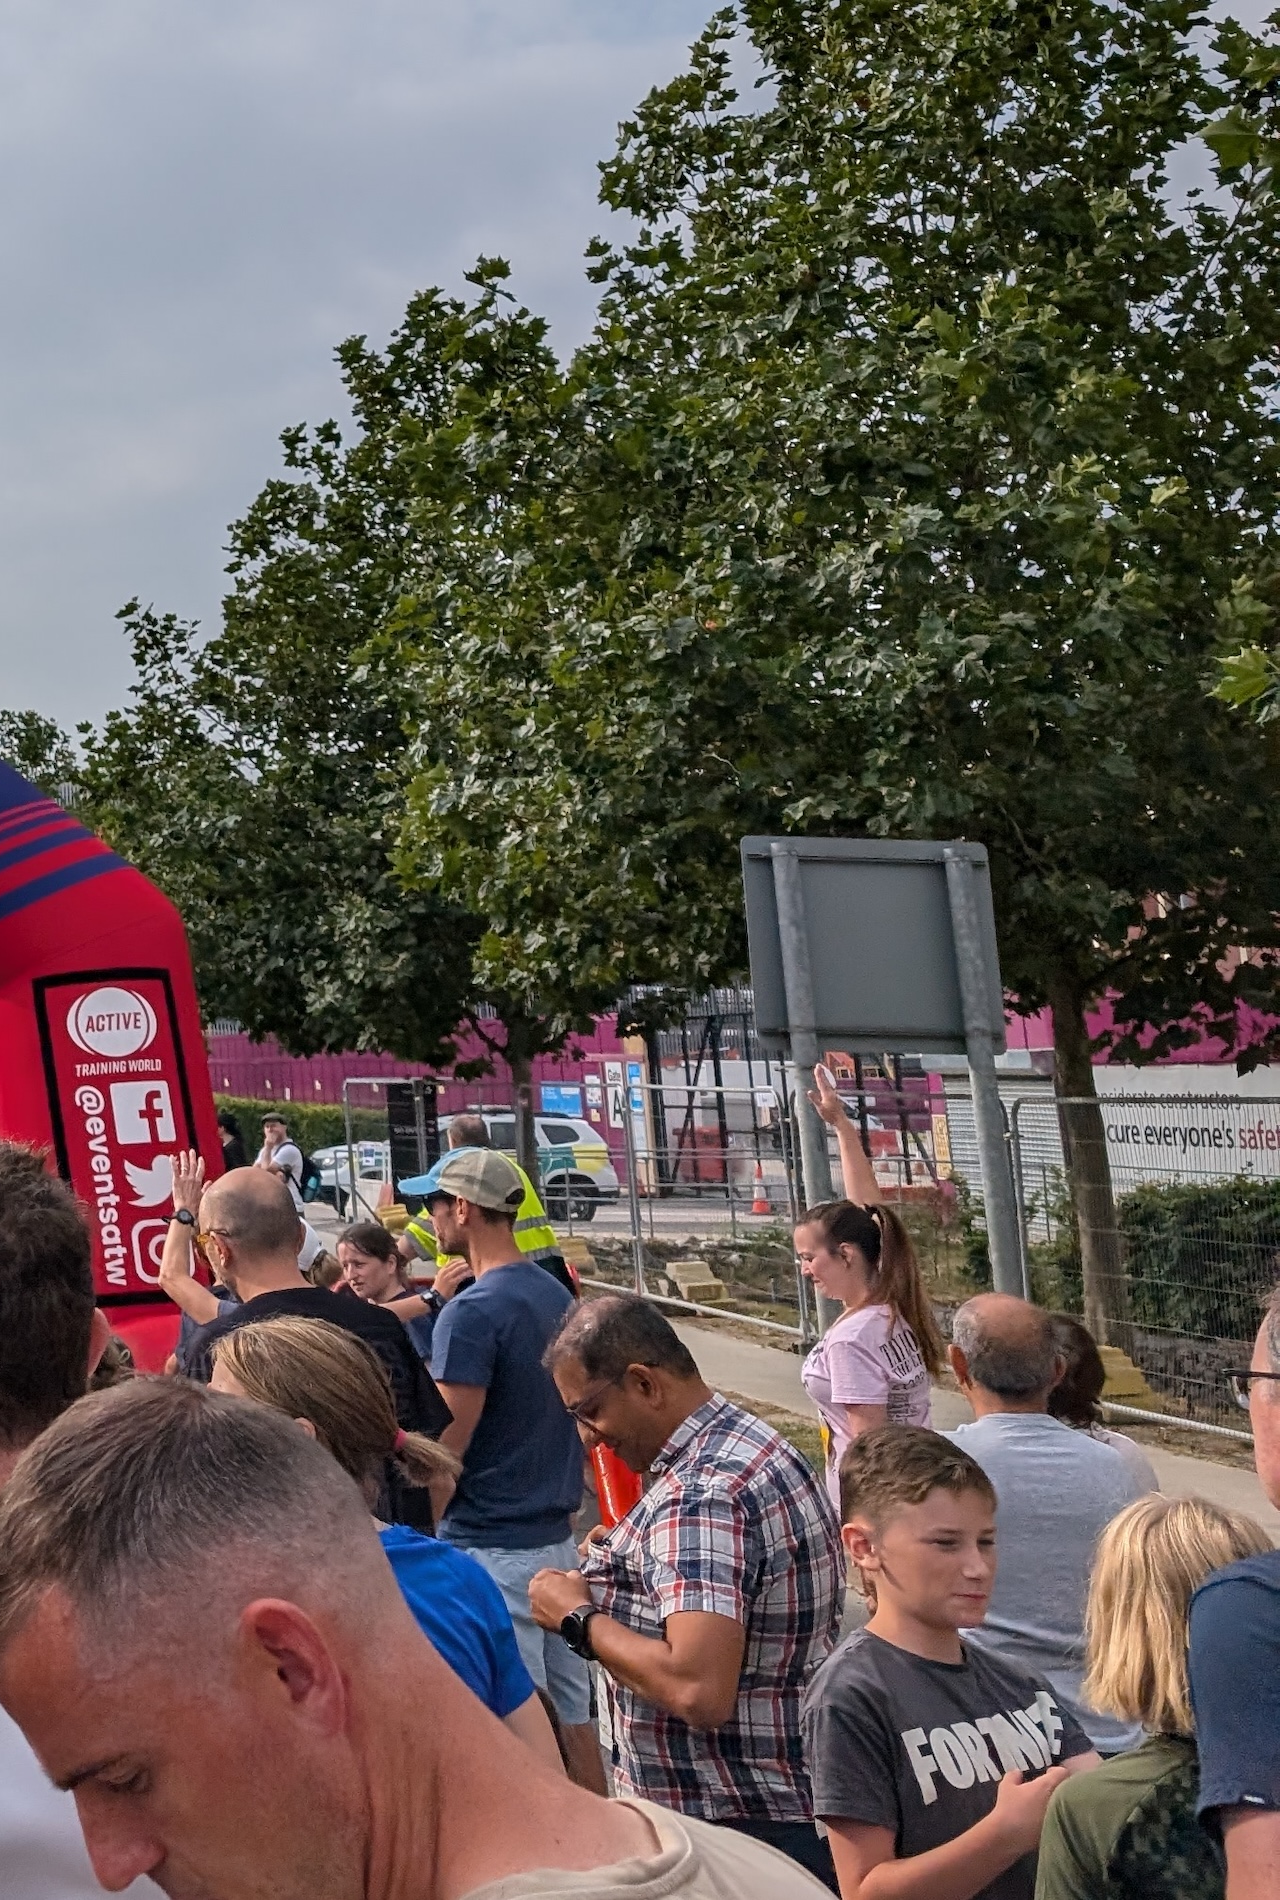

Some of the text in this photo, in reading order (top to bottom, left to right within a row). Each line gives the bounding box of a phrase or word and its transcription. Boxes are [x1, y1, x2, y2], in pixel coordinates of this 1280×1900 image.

[85, 1012, 142, 1033] ACTIVE
[75, 1059, 162, 1077] TRAINING WORLD
[1144, 1120, 1235, 1155] everyone's
[75, 1085, 128, 1286] @eventsatw
